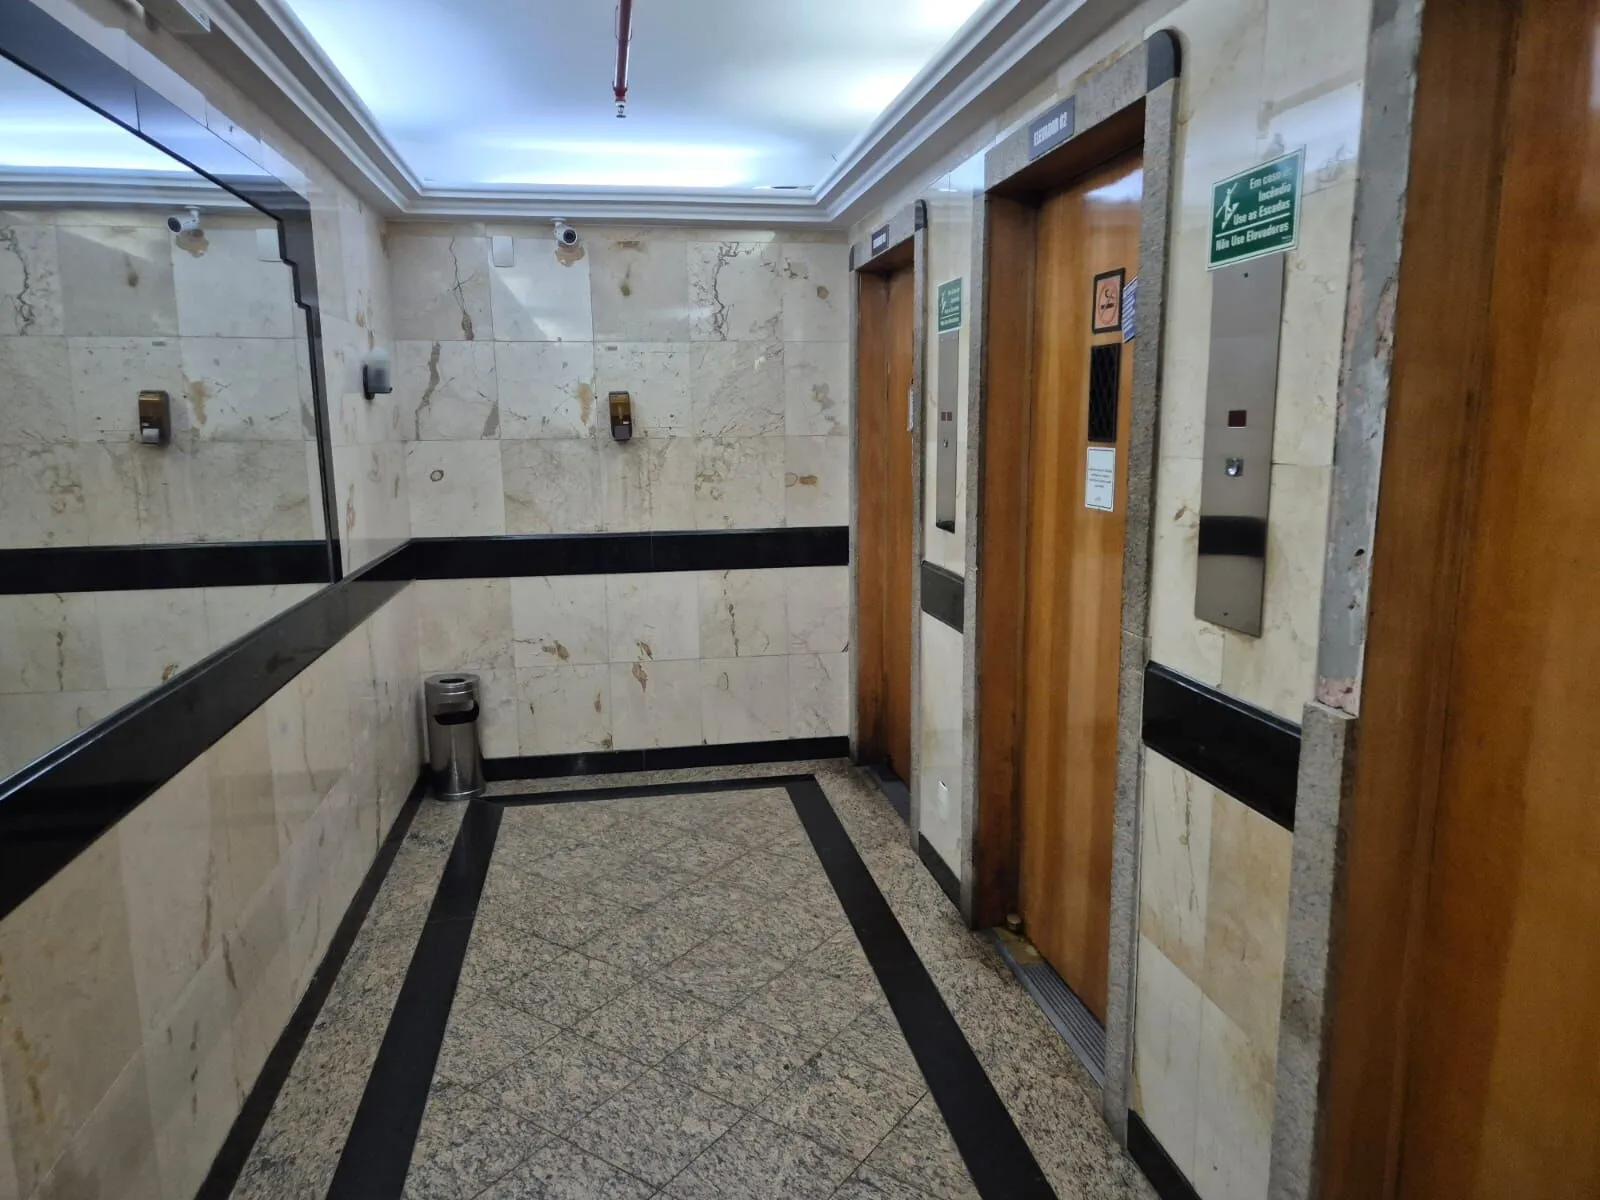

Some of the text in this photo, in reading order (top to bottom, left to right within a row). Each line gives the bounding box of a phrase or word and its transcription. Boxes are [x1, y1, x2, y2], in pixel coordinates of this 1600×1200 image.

[1249, 177, 1262, 190] Em
[1262, 170, 1281, 185] caso
[1233, 199, 1291, 226] Use as Escadas
[1215, 238, 1230, 251] Não
[1231, 234, 1245, 247] Use
[1246, 222, 1290, 242] Elevadores
